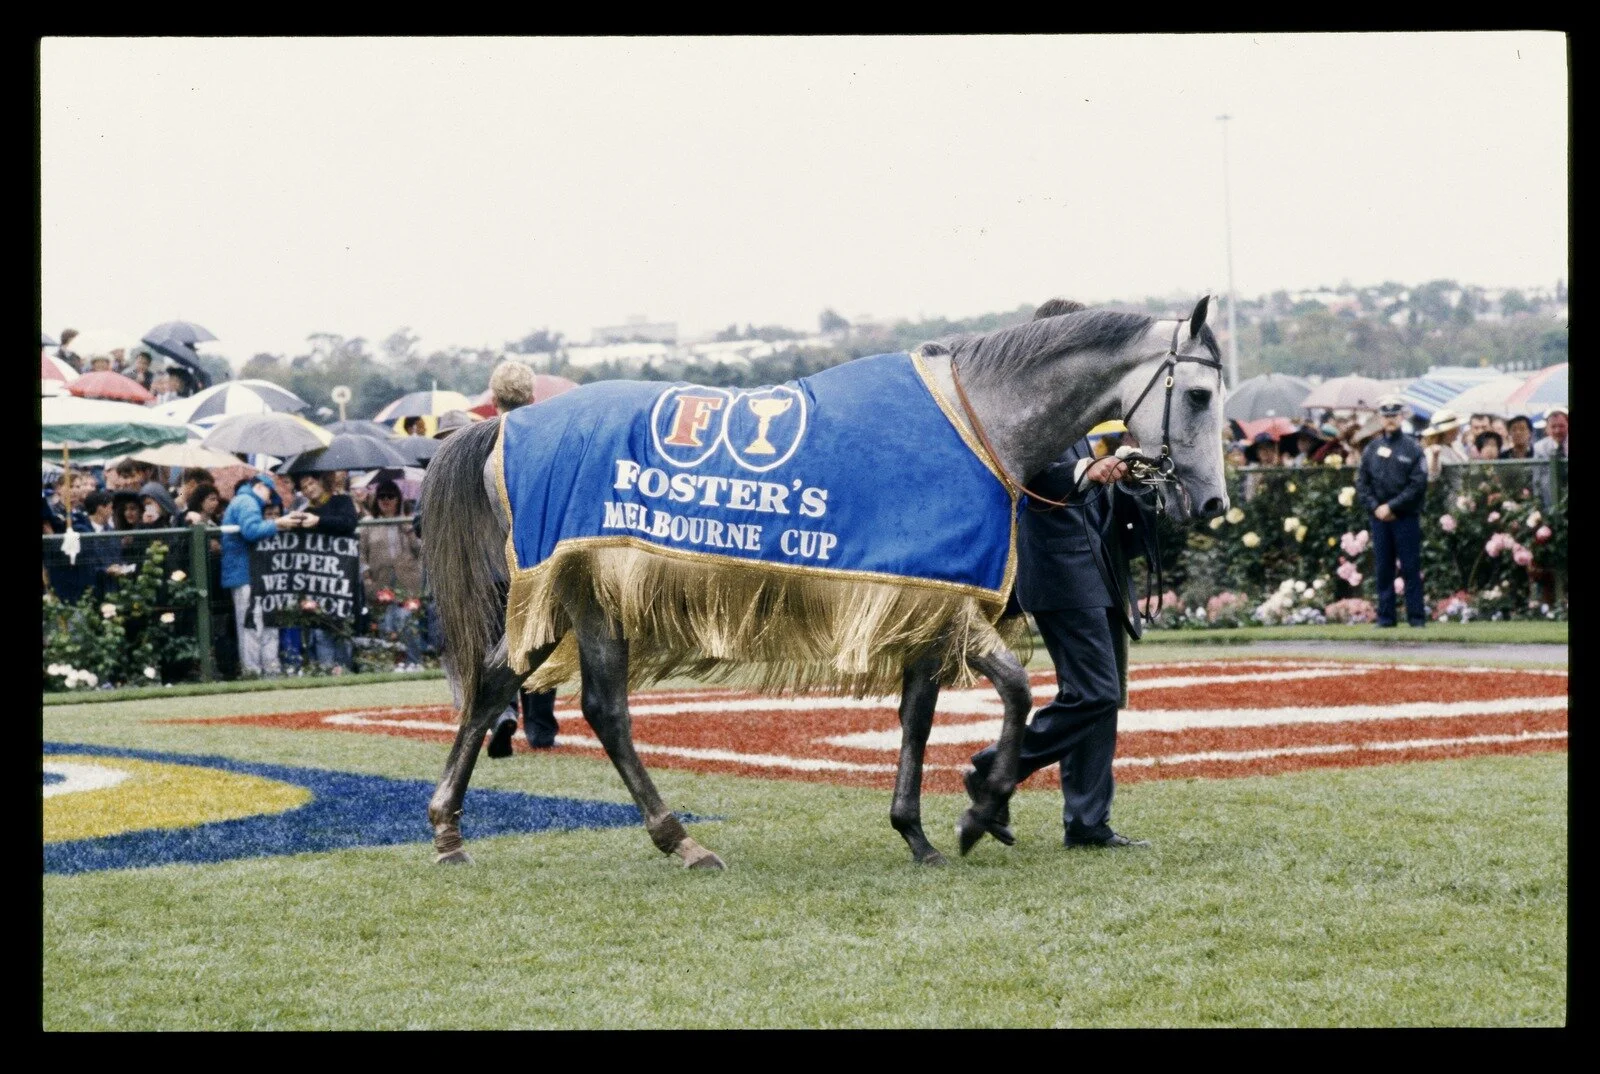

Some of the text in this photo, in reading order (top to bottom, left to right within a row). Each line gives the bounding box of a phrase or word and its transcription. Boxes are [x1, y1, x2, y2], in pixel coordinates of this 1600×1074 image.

[664, 395, 723, 447] F
[614, 459, 828, 518] FOSTER'S
[305, 533, 360, 557] LUCK
[603, 501, 837, 560] MELBOURNE CUP
[271, 552, 345, 579] SUPER,
[261, 573, 353, 598] WE STILL
